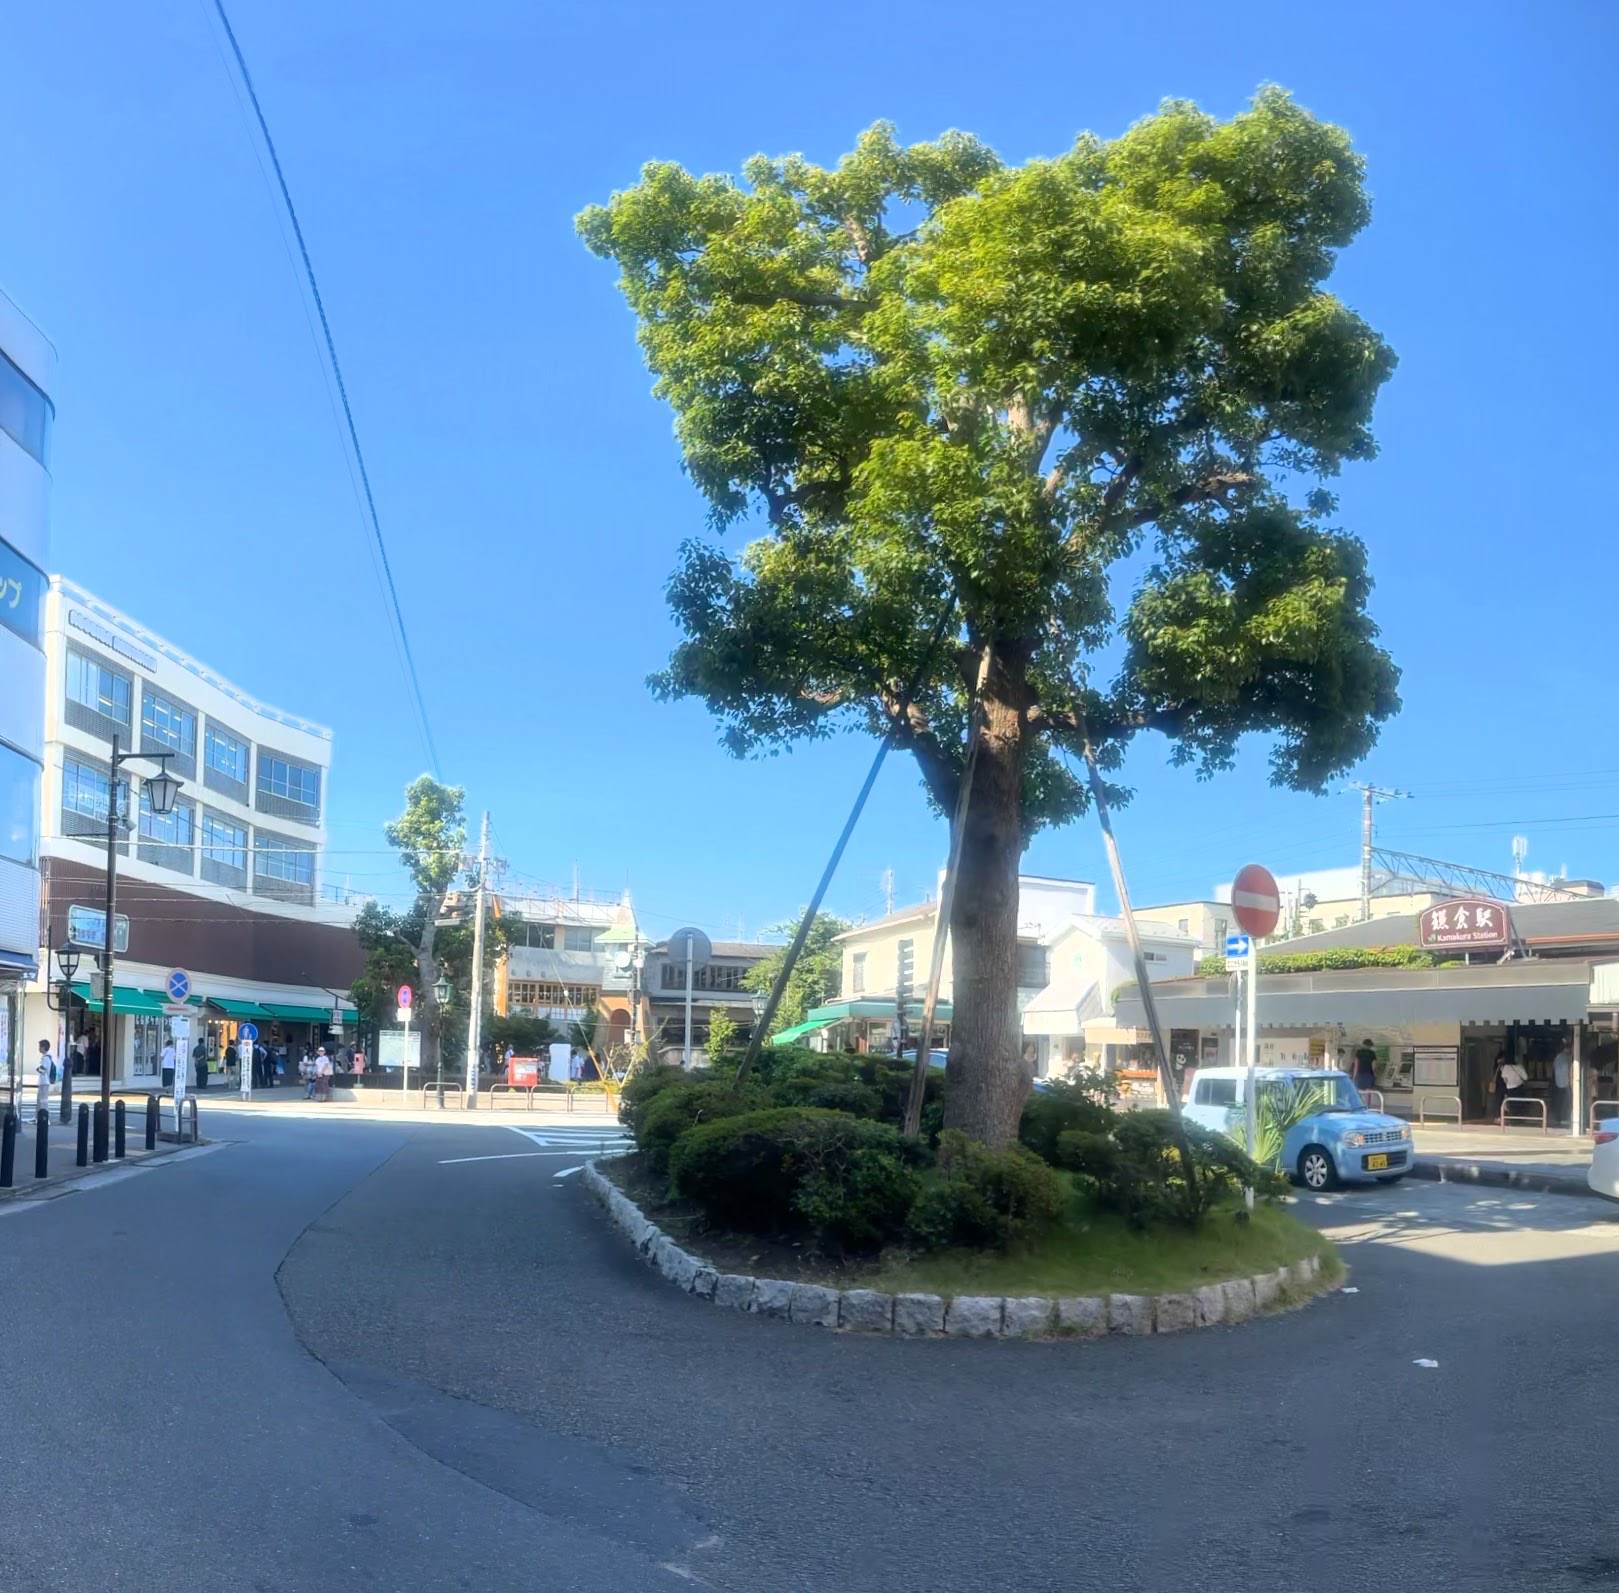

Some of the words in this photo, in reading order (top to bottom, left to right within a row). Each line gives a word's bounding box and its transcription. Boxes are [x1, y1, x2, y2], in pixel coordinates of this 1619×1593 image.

[1431, 906, 1493, 930] 鎌倉駅
[1437, 931, 1471, 942] Kamakura
[1473, 931, 1498, 940] Station
